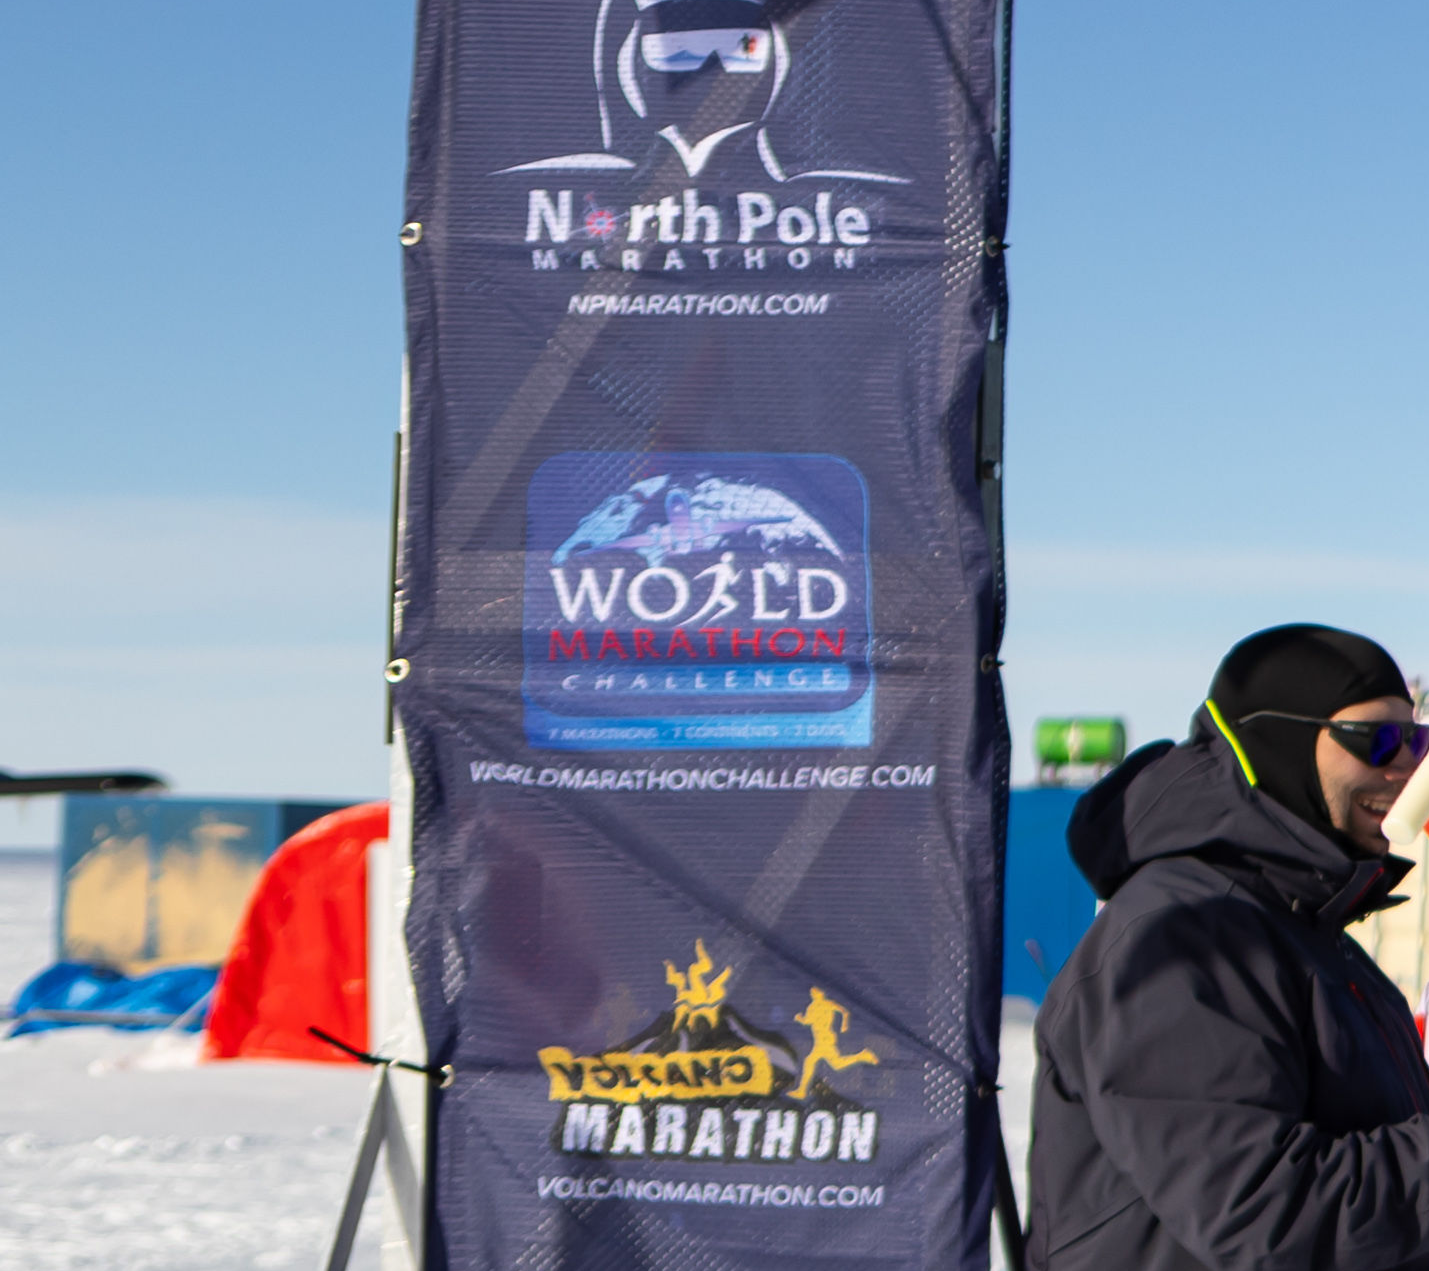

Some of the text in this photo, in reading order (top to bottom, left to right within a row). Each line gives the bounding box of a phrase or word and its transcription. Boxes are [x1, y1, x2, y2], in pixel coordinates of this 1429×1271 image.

[737, 192, 871, 246] Pole
[532, 248, 855, 272] MARATHON
[568, 293, 830, 316] NPMARATHON.COM
[548, 627, 847, 661] MARATHON
[562, 668, 838, 691] CHALLENGE
[470, 761, 937, 791] WORLDMARATHONCHALLENGE.COM
[551, 1054, 754, 1091] VOLCANO
[561, 1103, 878, 1162] MARATHON
[537, 1176, 885, 1207] VOLCANOMARATHON.COM
